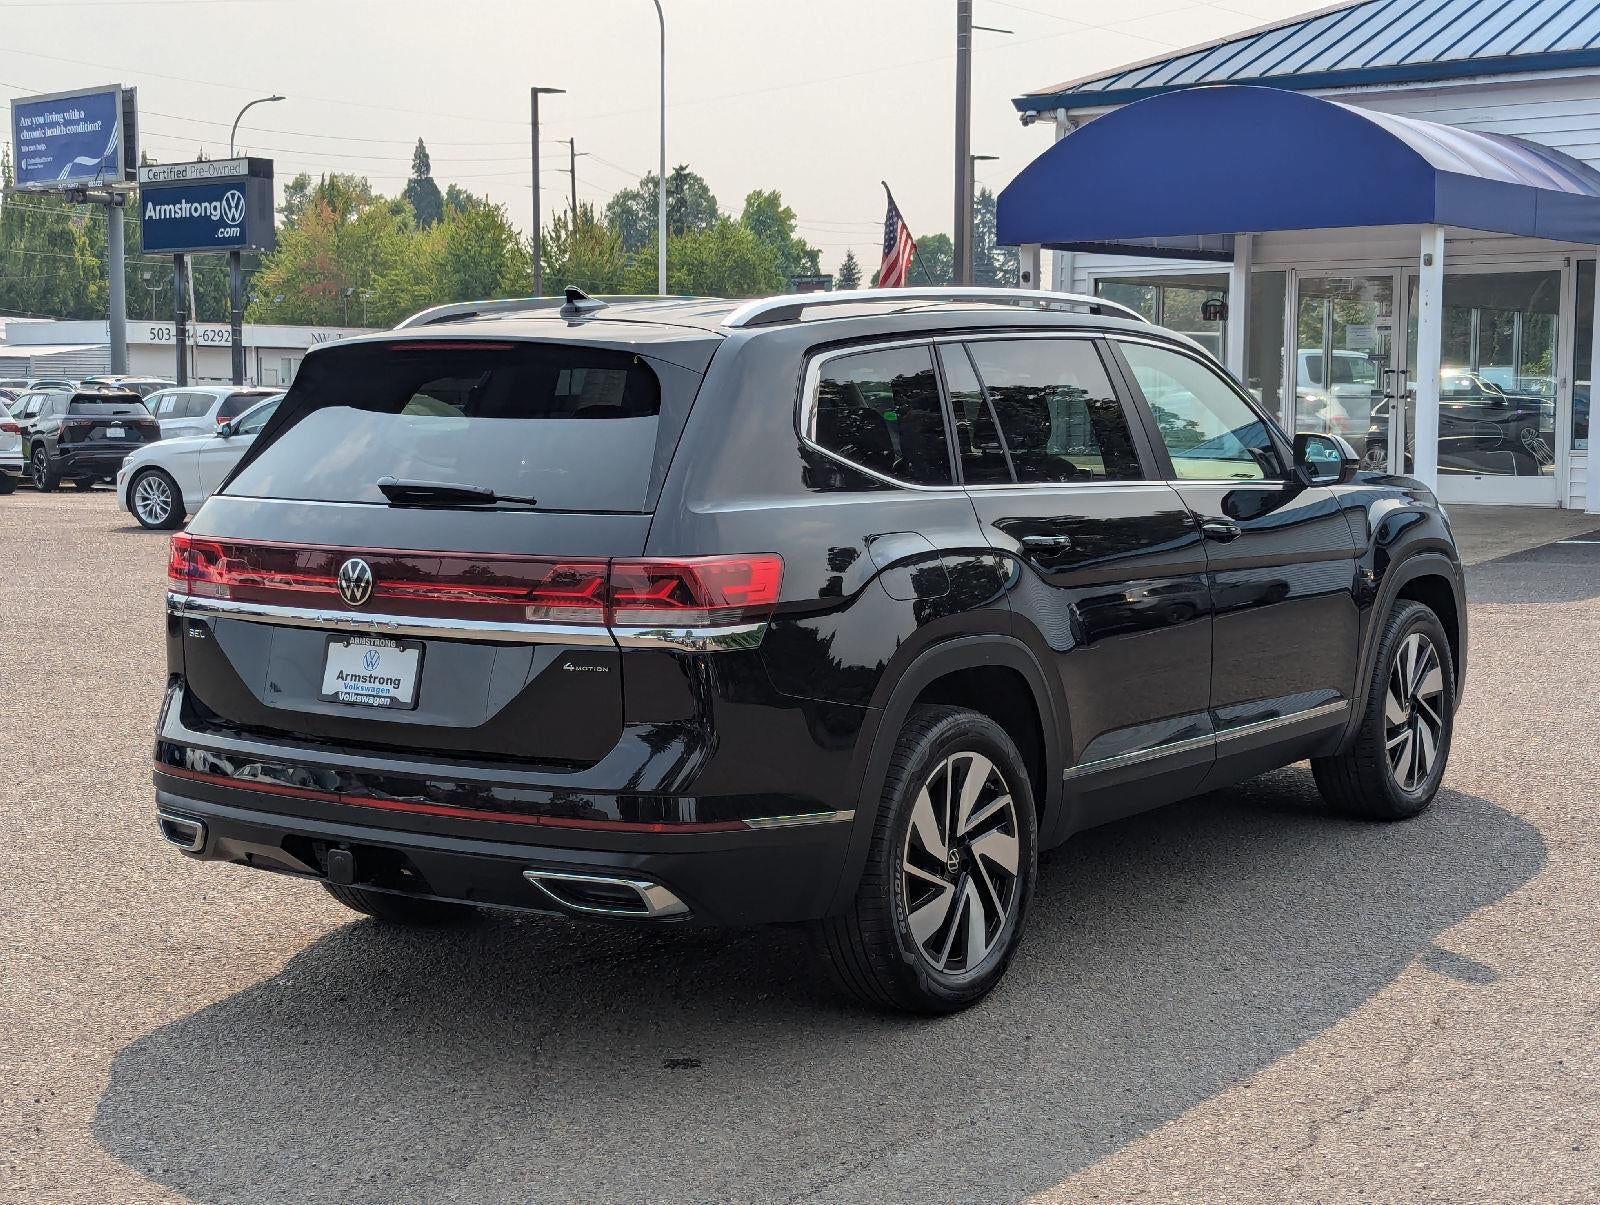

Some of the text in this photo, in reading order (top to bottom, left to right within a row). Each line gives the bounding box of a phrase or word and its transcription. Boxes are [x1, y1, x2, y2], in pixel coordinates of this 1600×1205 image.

[20, 116, 32, 127] Are
[32, 115, 45, 127] you
[45, 112, 64, 123] living
[64, 109, 79, 120] with
[20, 120, 102, 140] chronic health condition?
[147, 163, 241, 180] Certified Pre-Owned
[144, 199, 221, 221] Armstrong
[214, 226, 241, 238] .com
[189, 628, 205, 638] SEL
[349, 636, 397, 648] ARMSTRONG
[562, 661, 609, 672] 4MOTION
[336, 669, 402, 690] Armstrong
[343, 682, 391, 695] Volkswagen
[338, 691, 391, 706] Volkswagen
